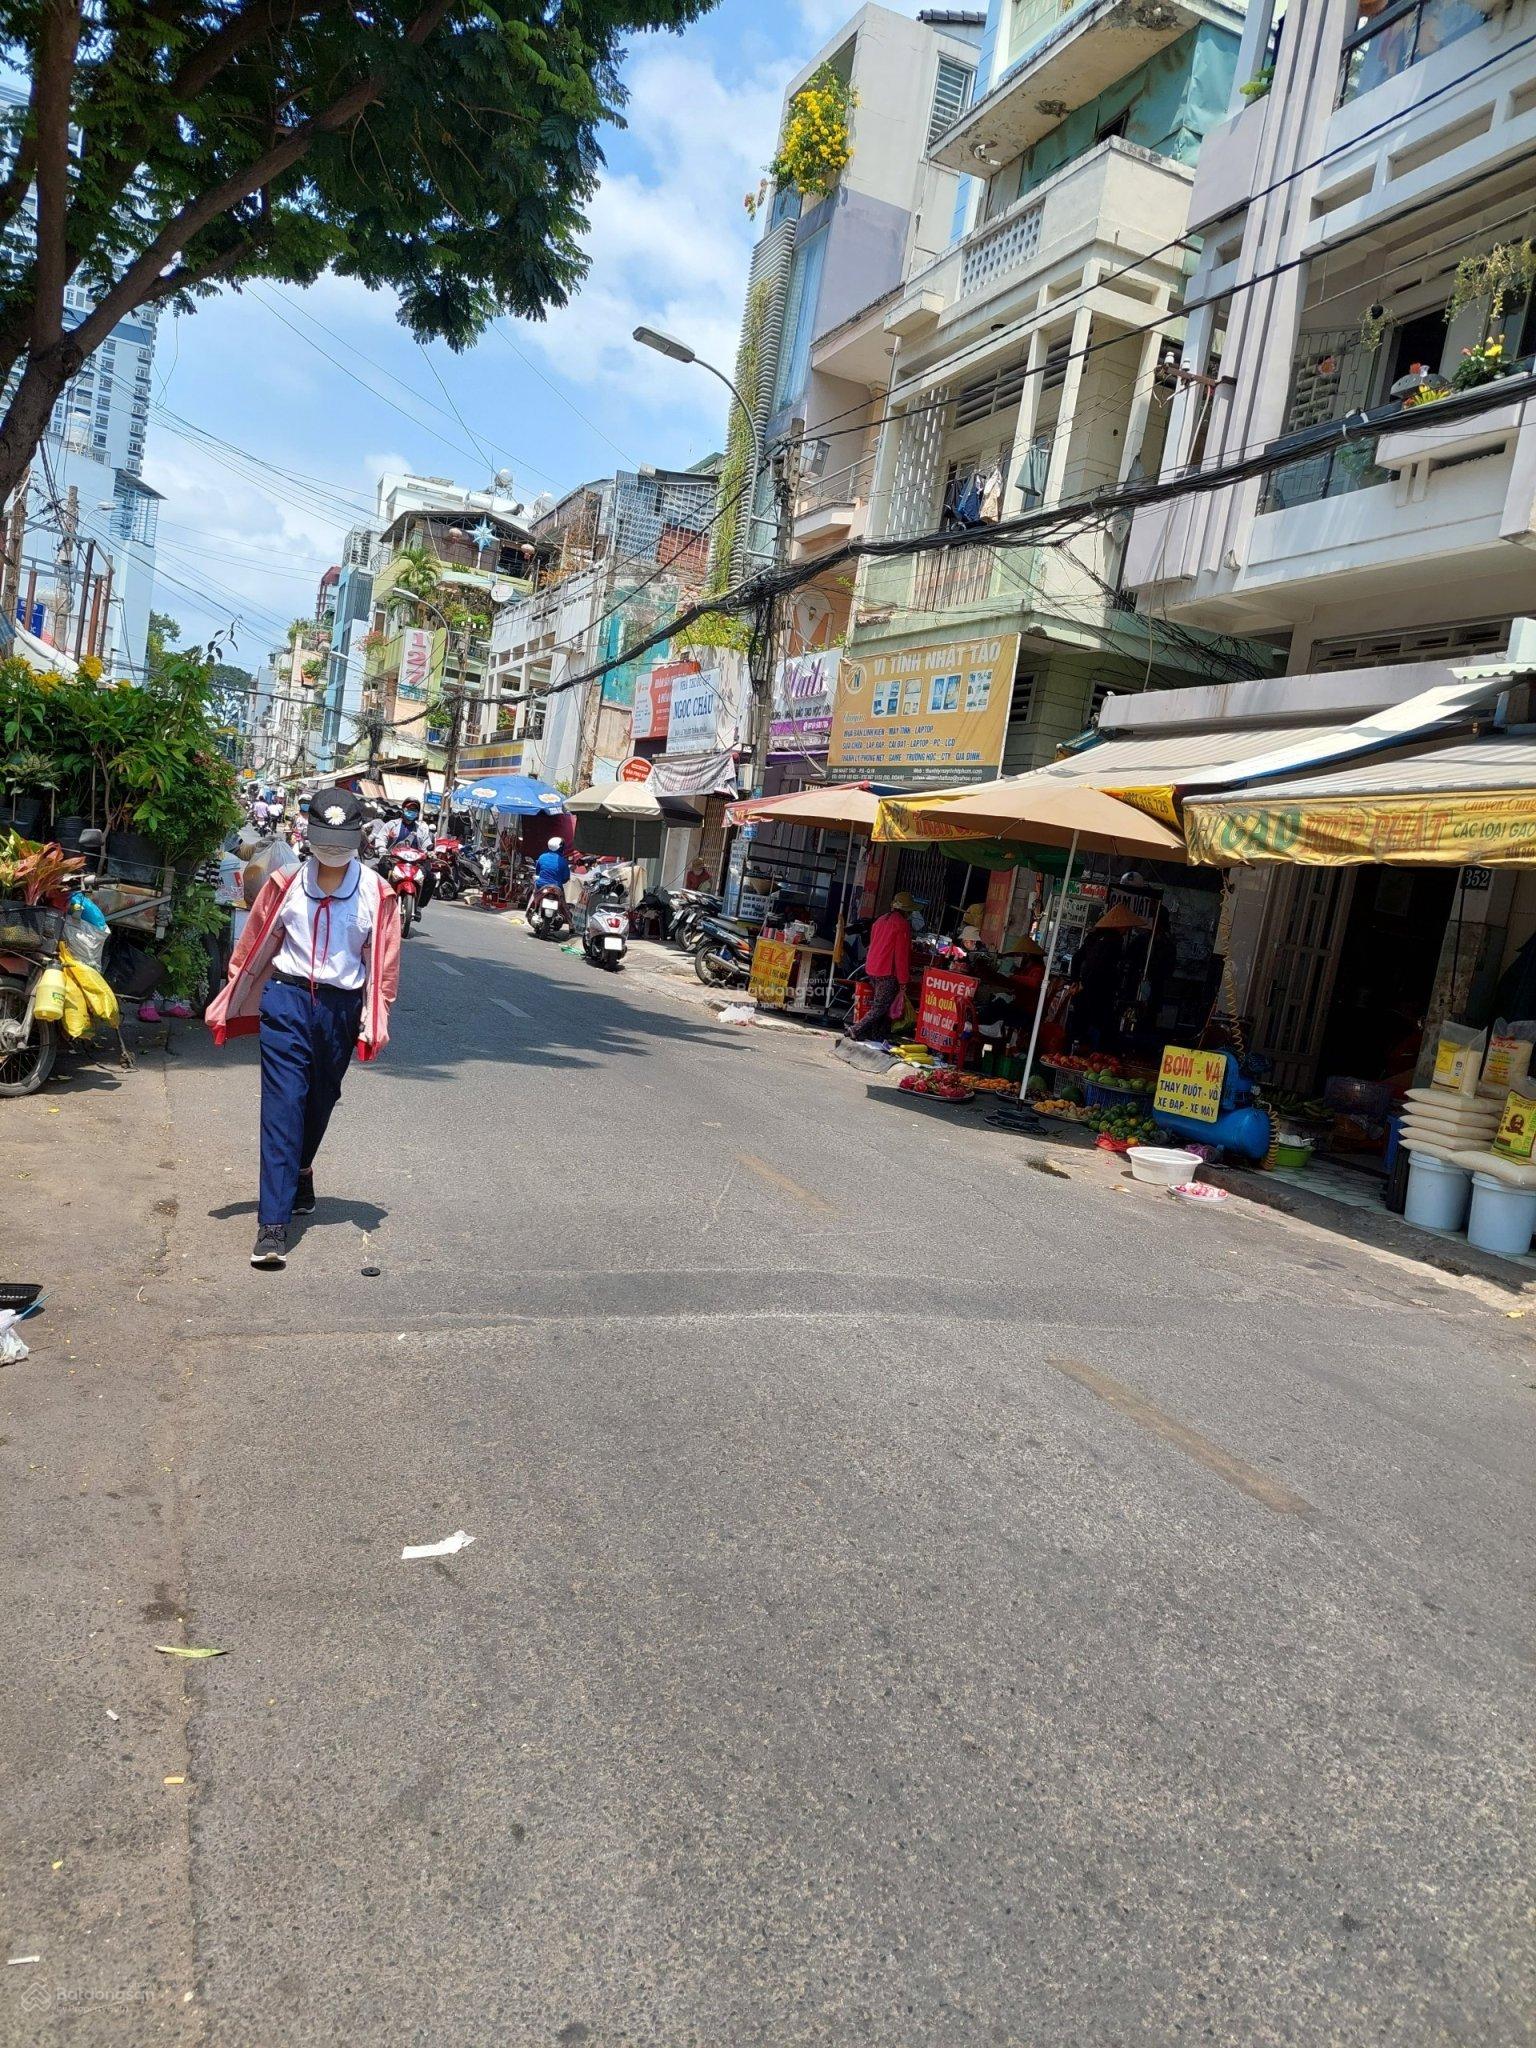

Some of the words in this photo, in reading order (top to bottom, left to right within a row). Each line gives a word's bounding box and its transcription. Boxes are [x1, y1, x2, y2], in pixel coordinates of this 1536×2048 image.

[673, 698, 692, 723] NGỌC
[1465, 869, 1490, 887] 352
[1164, 1054, 1194, 1078] BƠM
[1205, 1057, 1222, 1083] VÁ
[1160, 1080, 1181, 1093] THAY
[1157, 1097, 1168, 1107] XE
[1190, 1103, 1199, 1114] XE
